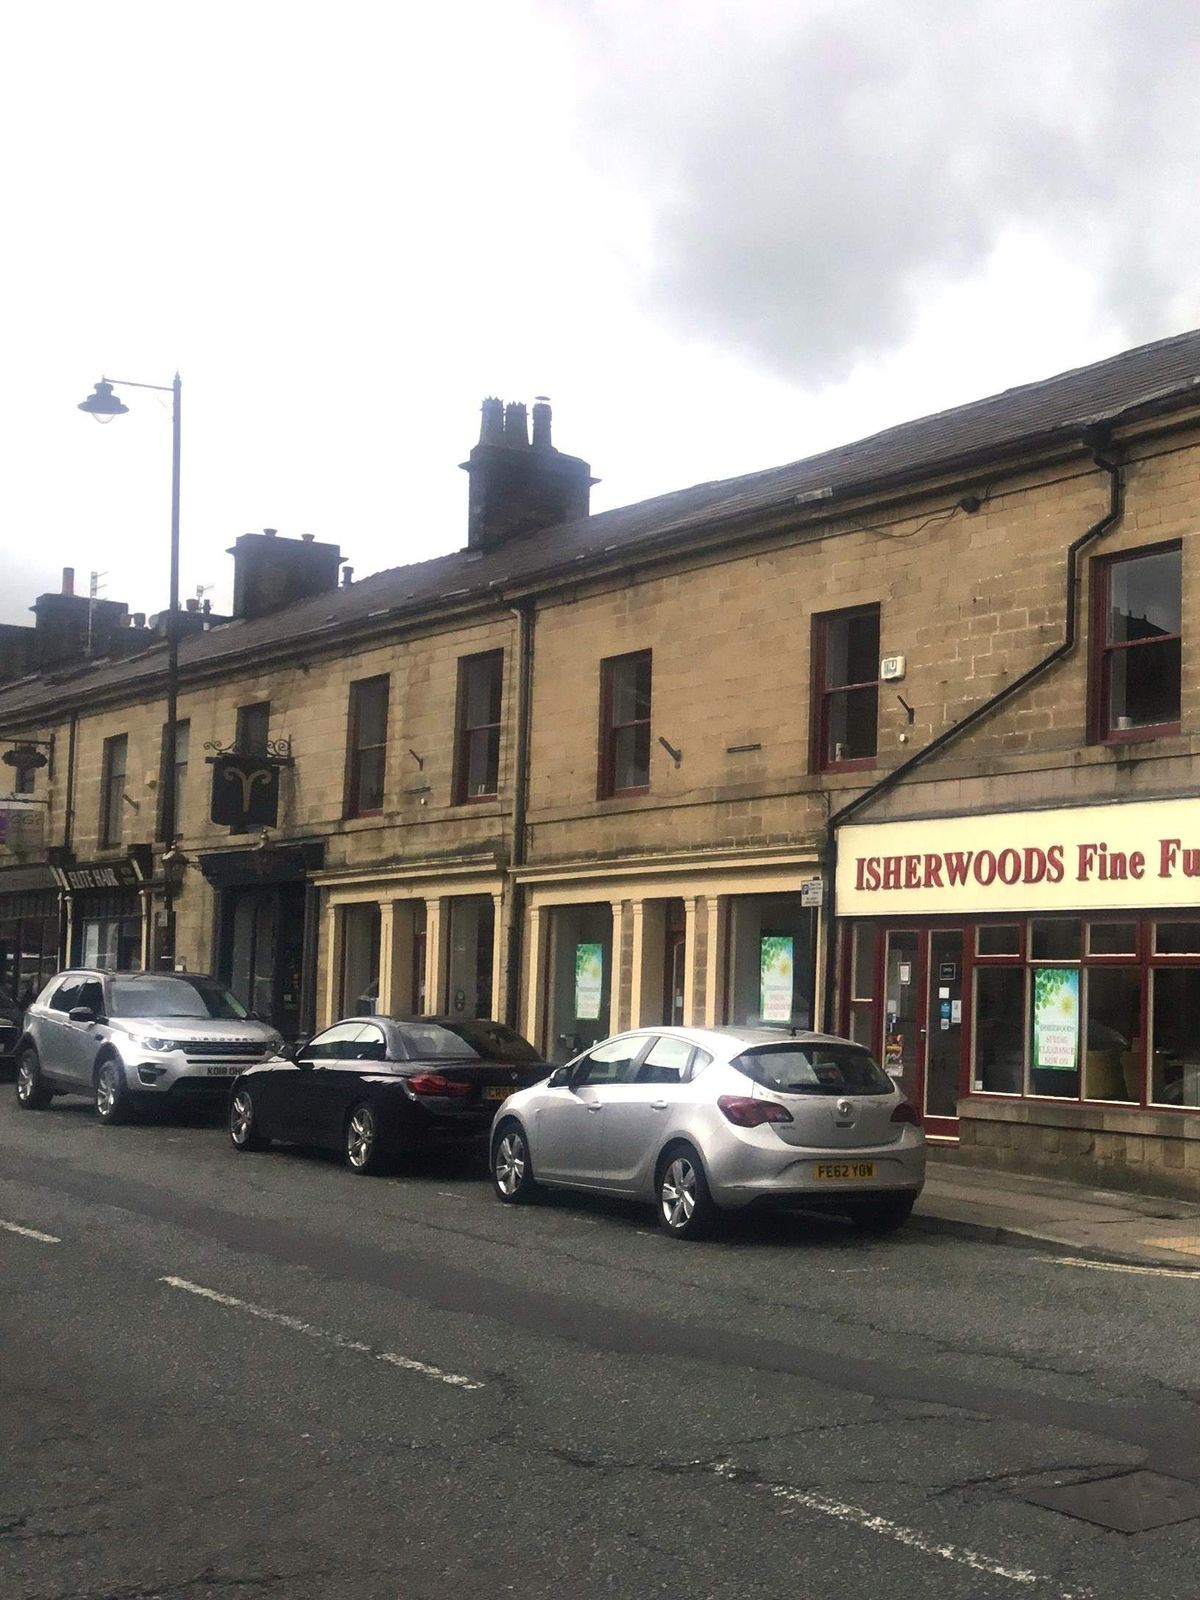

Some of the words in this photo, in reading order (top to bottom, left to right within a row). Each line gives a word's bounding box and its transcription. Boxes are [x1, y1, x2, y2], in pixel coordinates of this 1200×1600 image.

[854, 845, 1065, 891] ISHERWOODS
[1076, 842, 1146, 881] Fine
[67, 871, 95, 889] ELITE
[92, 868, 119, 887] HAIR
[818, 1165, 849, 1178] FE62
